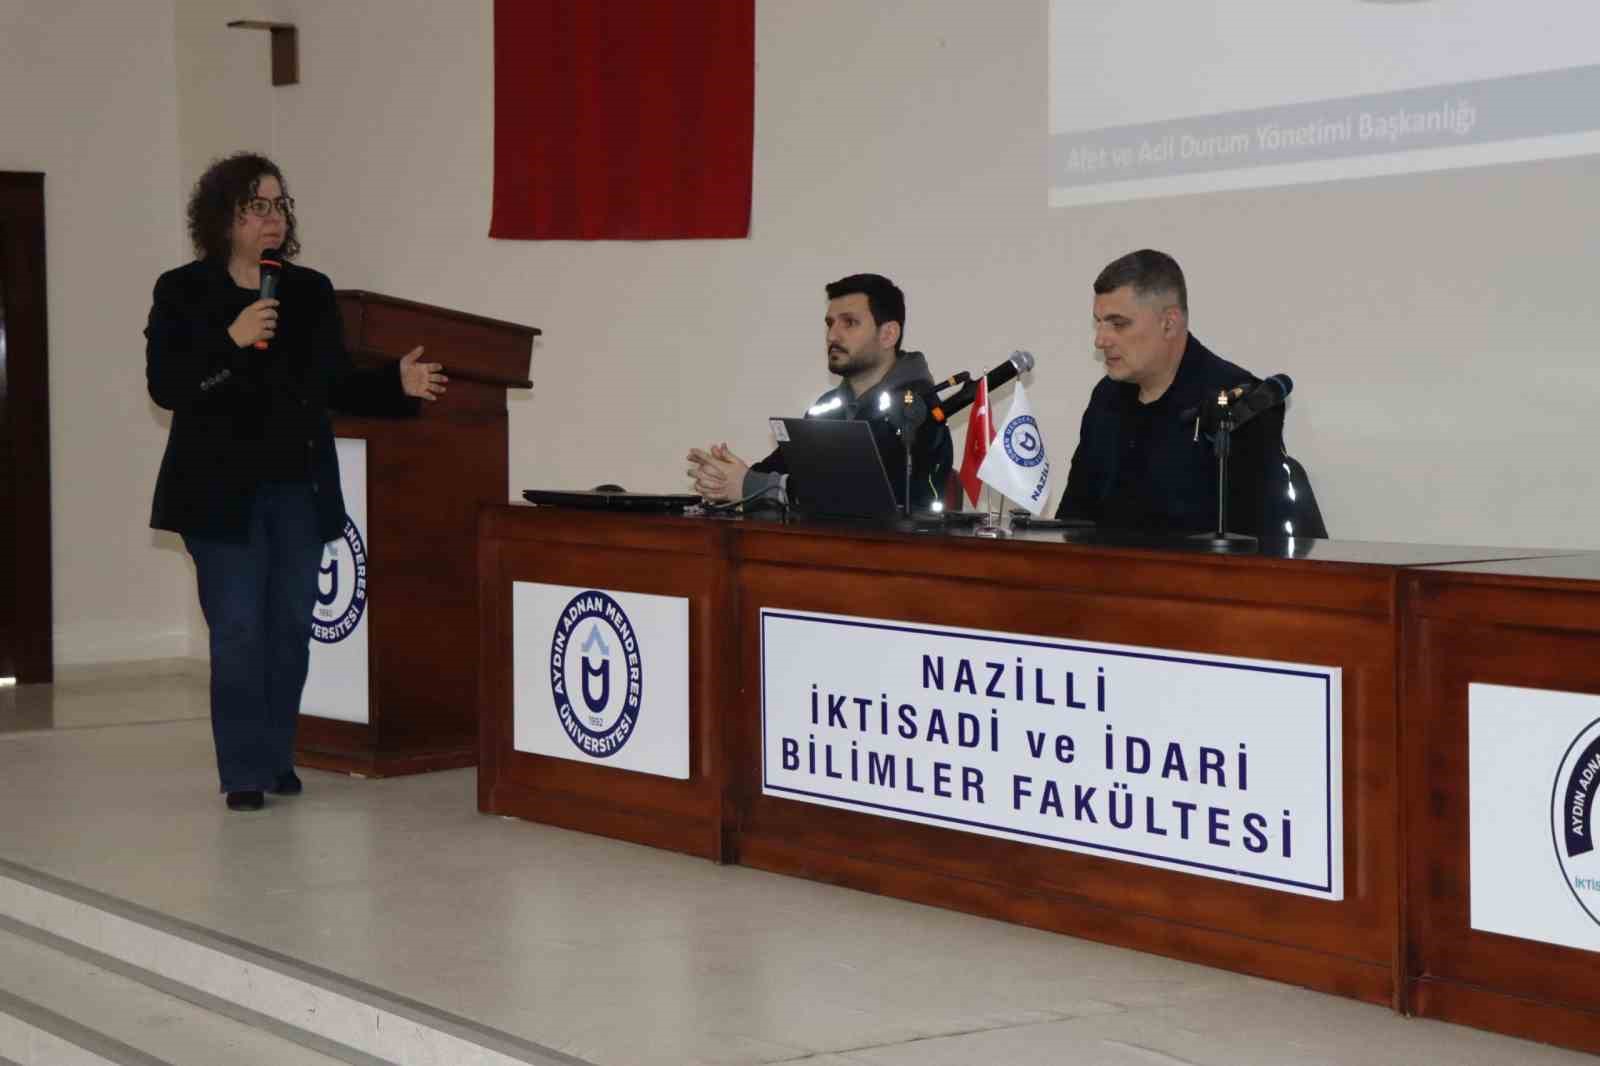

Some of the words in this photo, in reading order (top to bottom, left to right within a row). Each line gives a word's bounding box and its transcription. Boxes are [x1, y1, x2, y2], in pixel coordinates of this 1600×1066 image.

[1138, 138, 1175, 164] Acil
[1181, 133, 1249, 160] Durum
[1256, 115, 1352, 151] Yönetimi
[1359, 98, 1477, 142] Başkanlığı
[553, 636, 566, 694] AYDIN
[563, 597, 604, 630] ADNAN
[604, 602, 640, 708] MENDERES
[922, 654, 1107, 713] NAZİLLİ
[811, 683, 999, 753] İKTİSADİ
[1025, 729, 1076, 764] ve
[1105, 723, 1249, 791] İDARİ
[781, 733, 986, 804] BİLİMLER
[1013, 774, 1293, 859] FAKÜLTESİ
[1572, 791, 1585, 835] AYDIN
